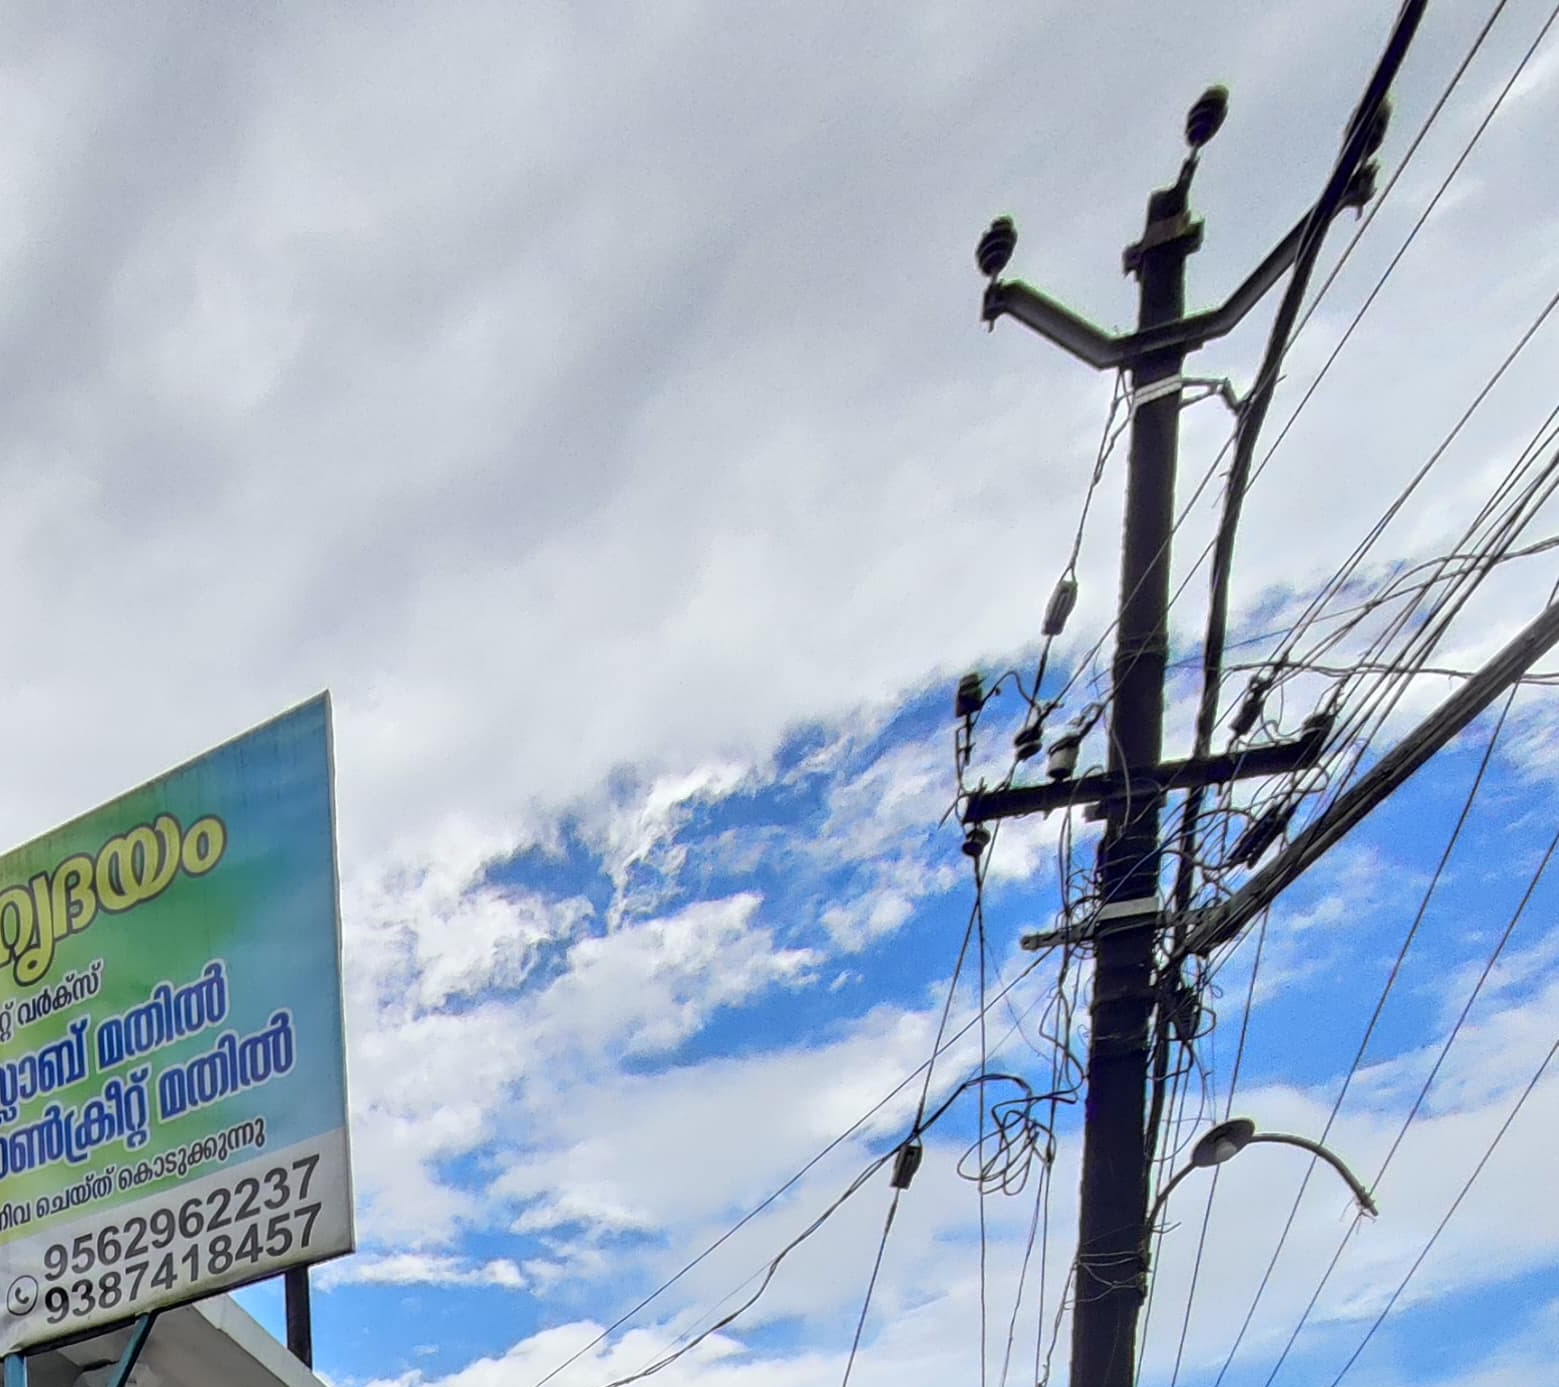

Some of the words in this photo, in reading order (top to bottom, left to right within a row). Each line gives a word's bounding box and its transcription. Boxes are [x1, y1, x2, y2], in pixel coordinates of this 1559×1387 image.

[97, 962, 227, 1070] മതിൽ
[158, 1011, 294, 1121] മതിൽ
[44, 1154, 321, 1283] 9562962237
[45, 1203, 323, 1325] 9387418457
